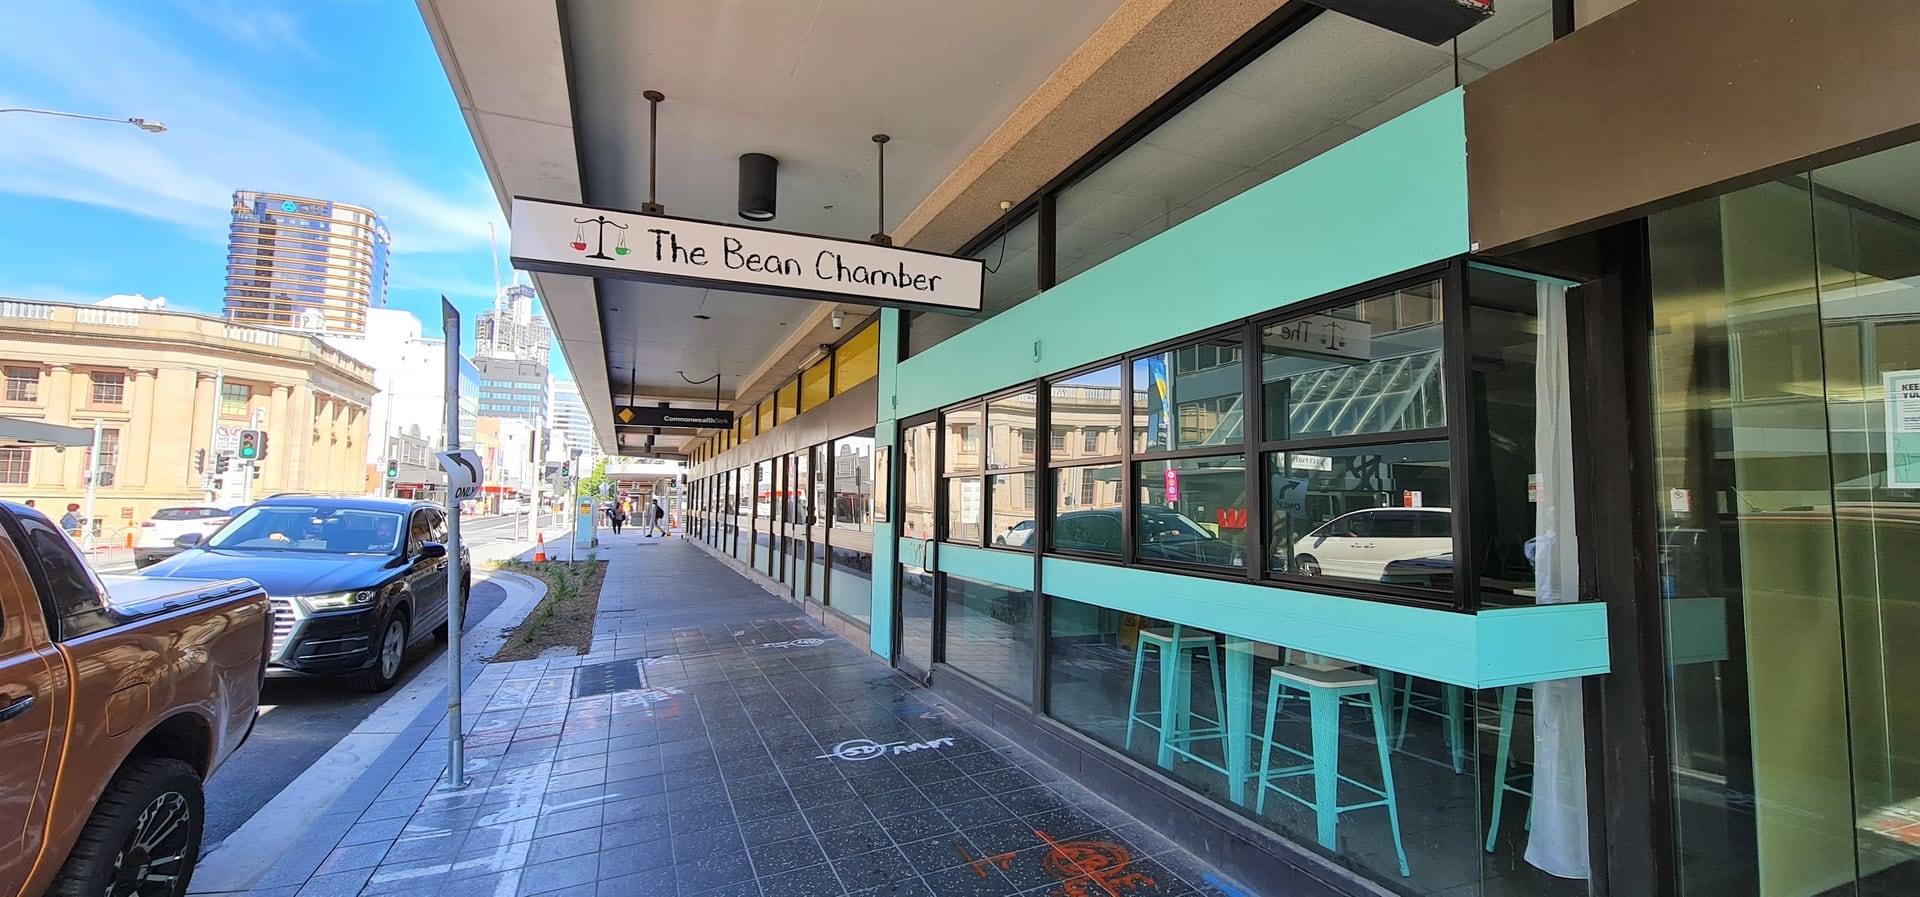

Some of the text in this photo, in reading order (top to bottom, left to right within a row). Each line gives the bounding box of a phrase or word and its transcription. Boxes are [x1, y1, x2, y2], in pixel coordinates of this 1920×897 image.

[648, 228, 942, 291] The Bean Chamber
[455, 486, 477, 498] ONLY
